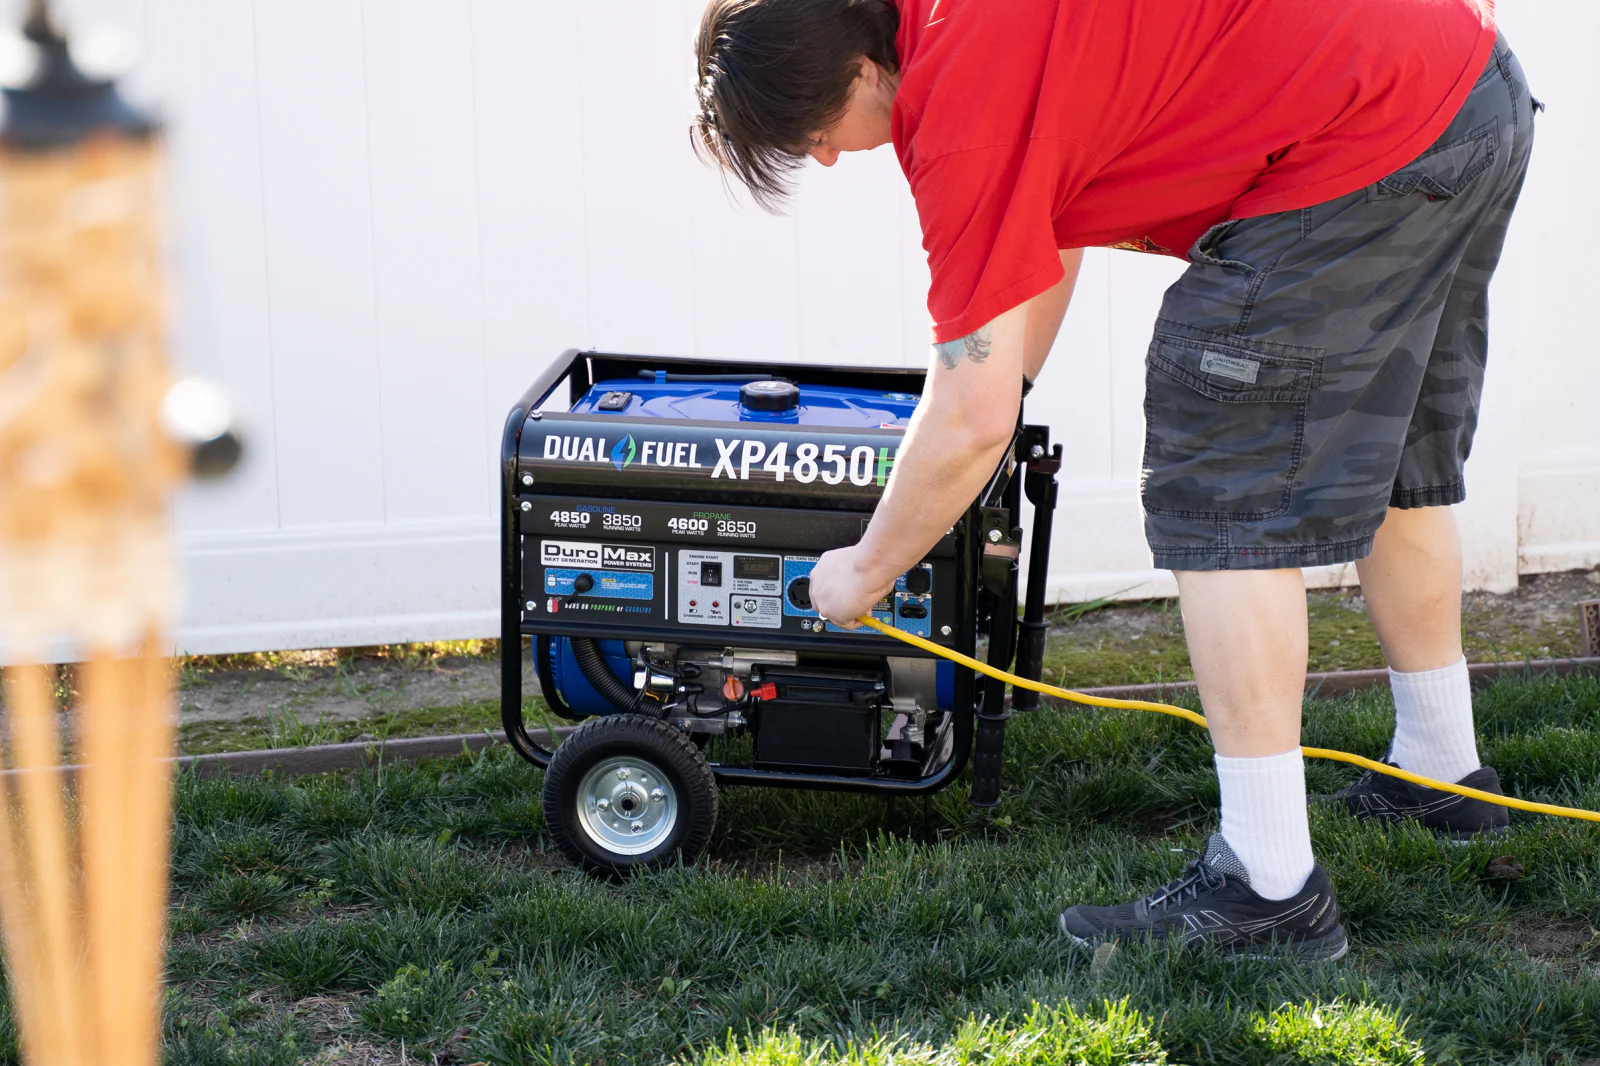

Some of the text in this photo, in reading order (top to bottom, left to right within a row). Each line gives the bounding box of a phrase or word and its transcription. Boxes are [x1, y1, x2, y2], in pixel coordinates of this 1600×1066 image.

[543, 435, 702, 468] DUAL FUEL
[576, 504, 616, 514] GASOLINE
[693, 511, 731, 520] PROPANE
[550, 510, 642, 527] 4850 3850
[667, 517, 757, 534] 4600 3650
[544, 544, 652, 562] Duro Max
[589, 603, 615, 612] PROPANE
[624, 606, 652, 614] GASOLINE
